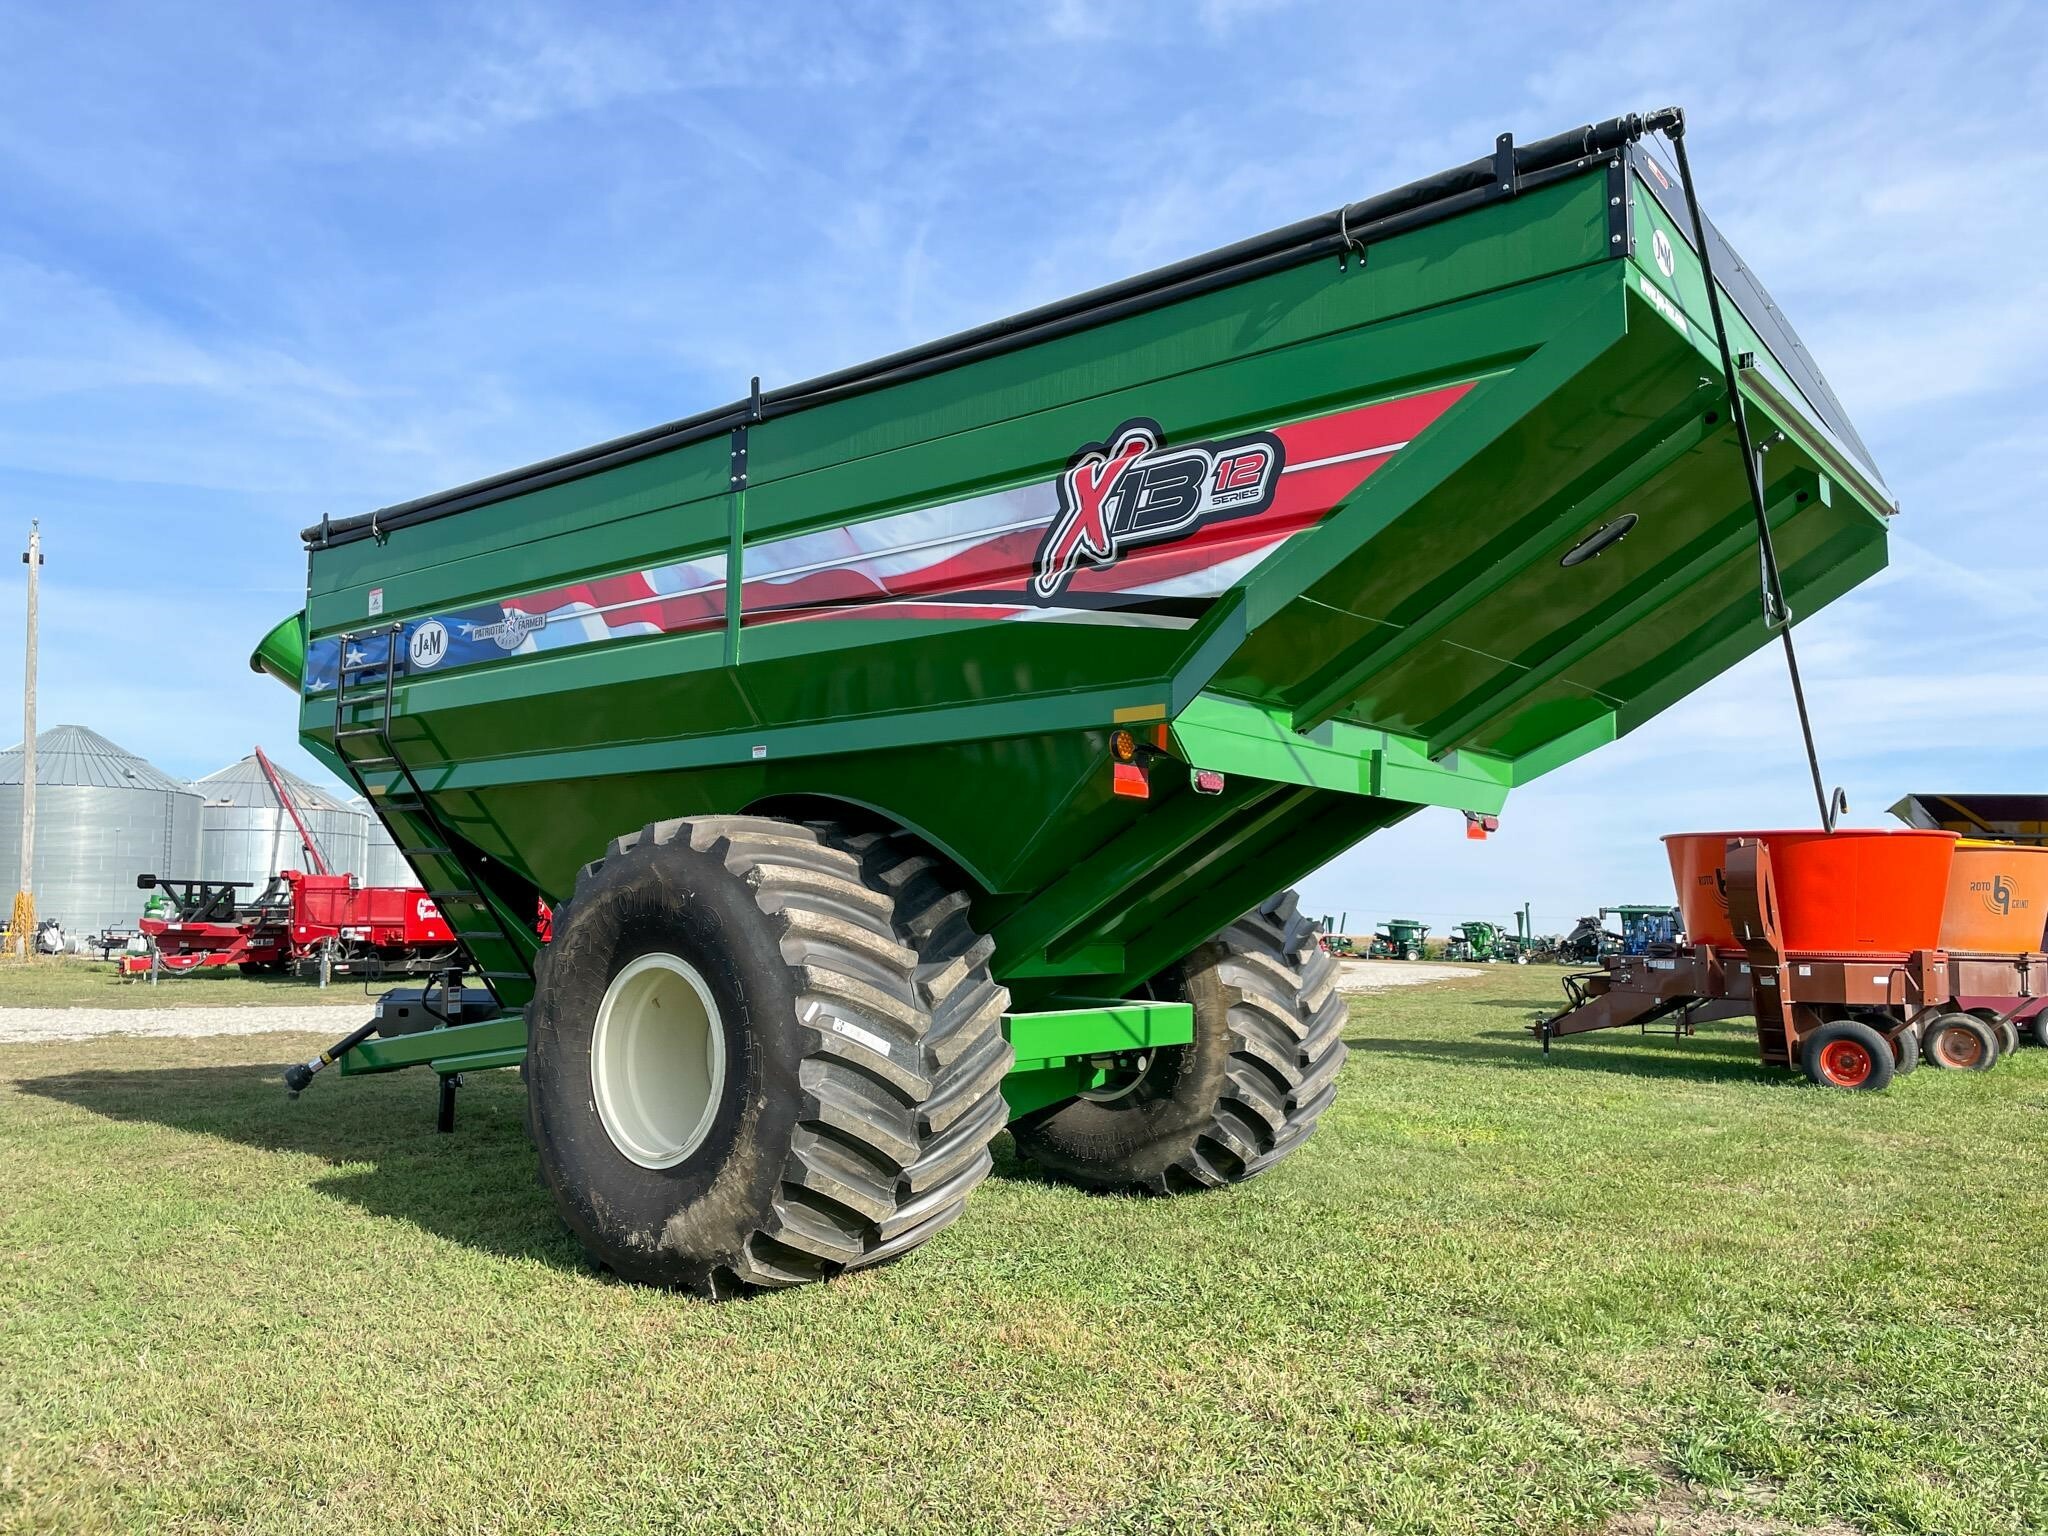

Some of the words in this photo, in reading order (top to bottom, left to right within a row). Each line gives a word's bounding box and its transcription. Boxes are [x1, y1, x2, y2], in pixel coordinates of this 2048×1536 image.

[1214, 452, 1266, 493] 12
[1212, 488, 1260, 506] SERIES
[474, 624, 505, 639] PATRIOTIC
[518, 616, 543, 630] FARMER
[413, 629, 443, 658] J&M
[1970, 881, 1991, 891] ROTO
